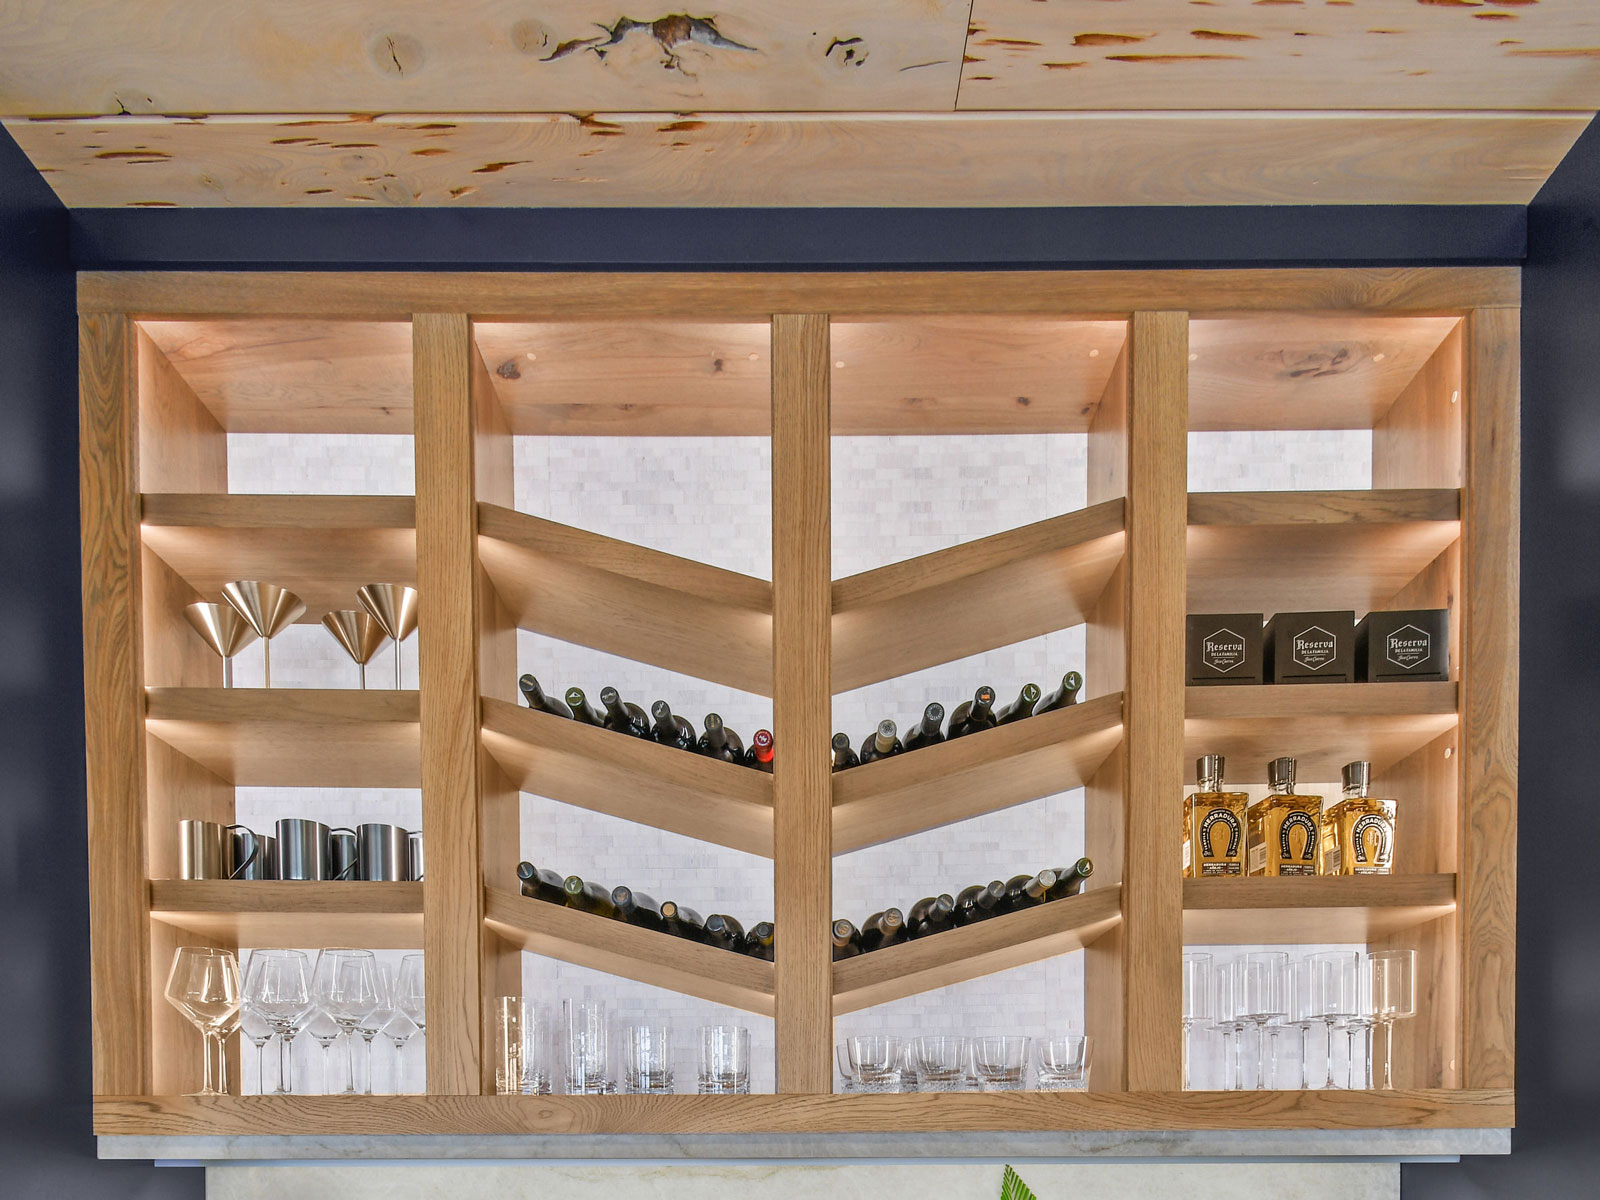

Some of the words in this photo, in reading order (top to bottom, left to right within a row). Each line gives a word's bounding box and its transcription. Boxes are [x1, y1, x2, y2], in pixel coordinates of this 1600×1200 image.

[1206, 641, 1242, 652] Reserva
[1296, 639, 1333, 650] Reserva
[1390, 638, 1428, 649] Reserva
[1203, 812, 1237, 828] HERRADURA
[1283, 815, 1314, 830] HERRADURA
